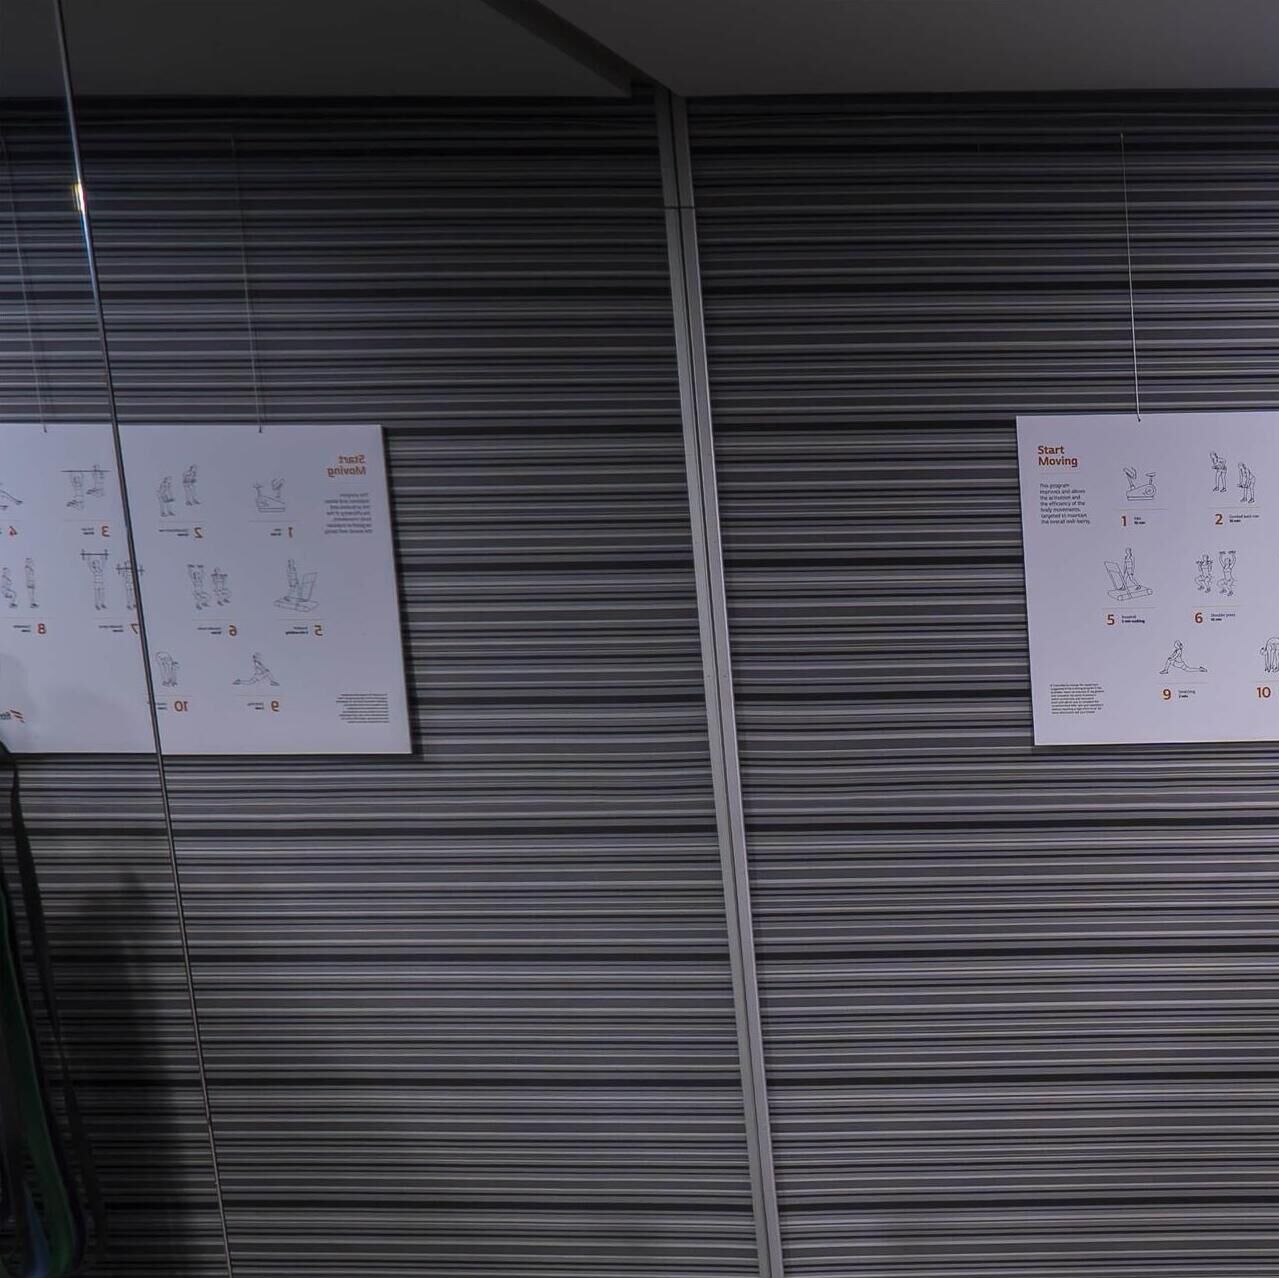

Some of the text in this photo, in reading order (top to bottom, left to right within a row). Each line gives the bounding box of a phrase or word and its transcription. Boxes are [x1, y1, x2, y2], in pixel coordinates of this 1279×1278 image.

[1038, 445, 1064, 455] Start
[1038, 456, 1078, 468] Moving
[1120, 516, 1127, 526] 1
[1215, 514, 1223, 525] 2
[1107, 614, 1115, 625] 5
[1194, 612, 1203, 623] 6
[1163, 689, 1171, 700] 9
[1257, 687, 1271, 698] 10
